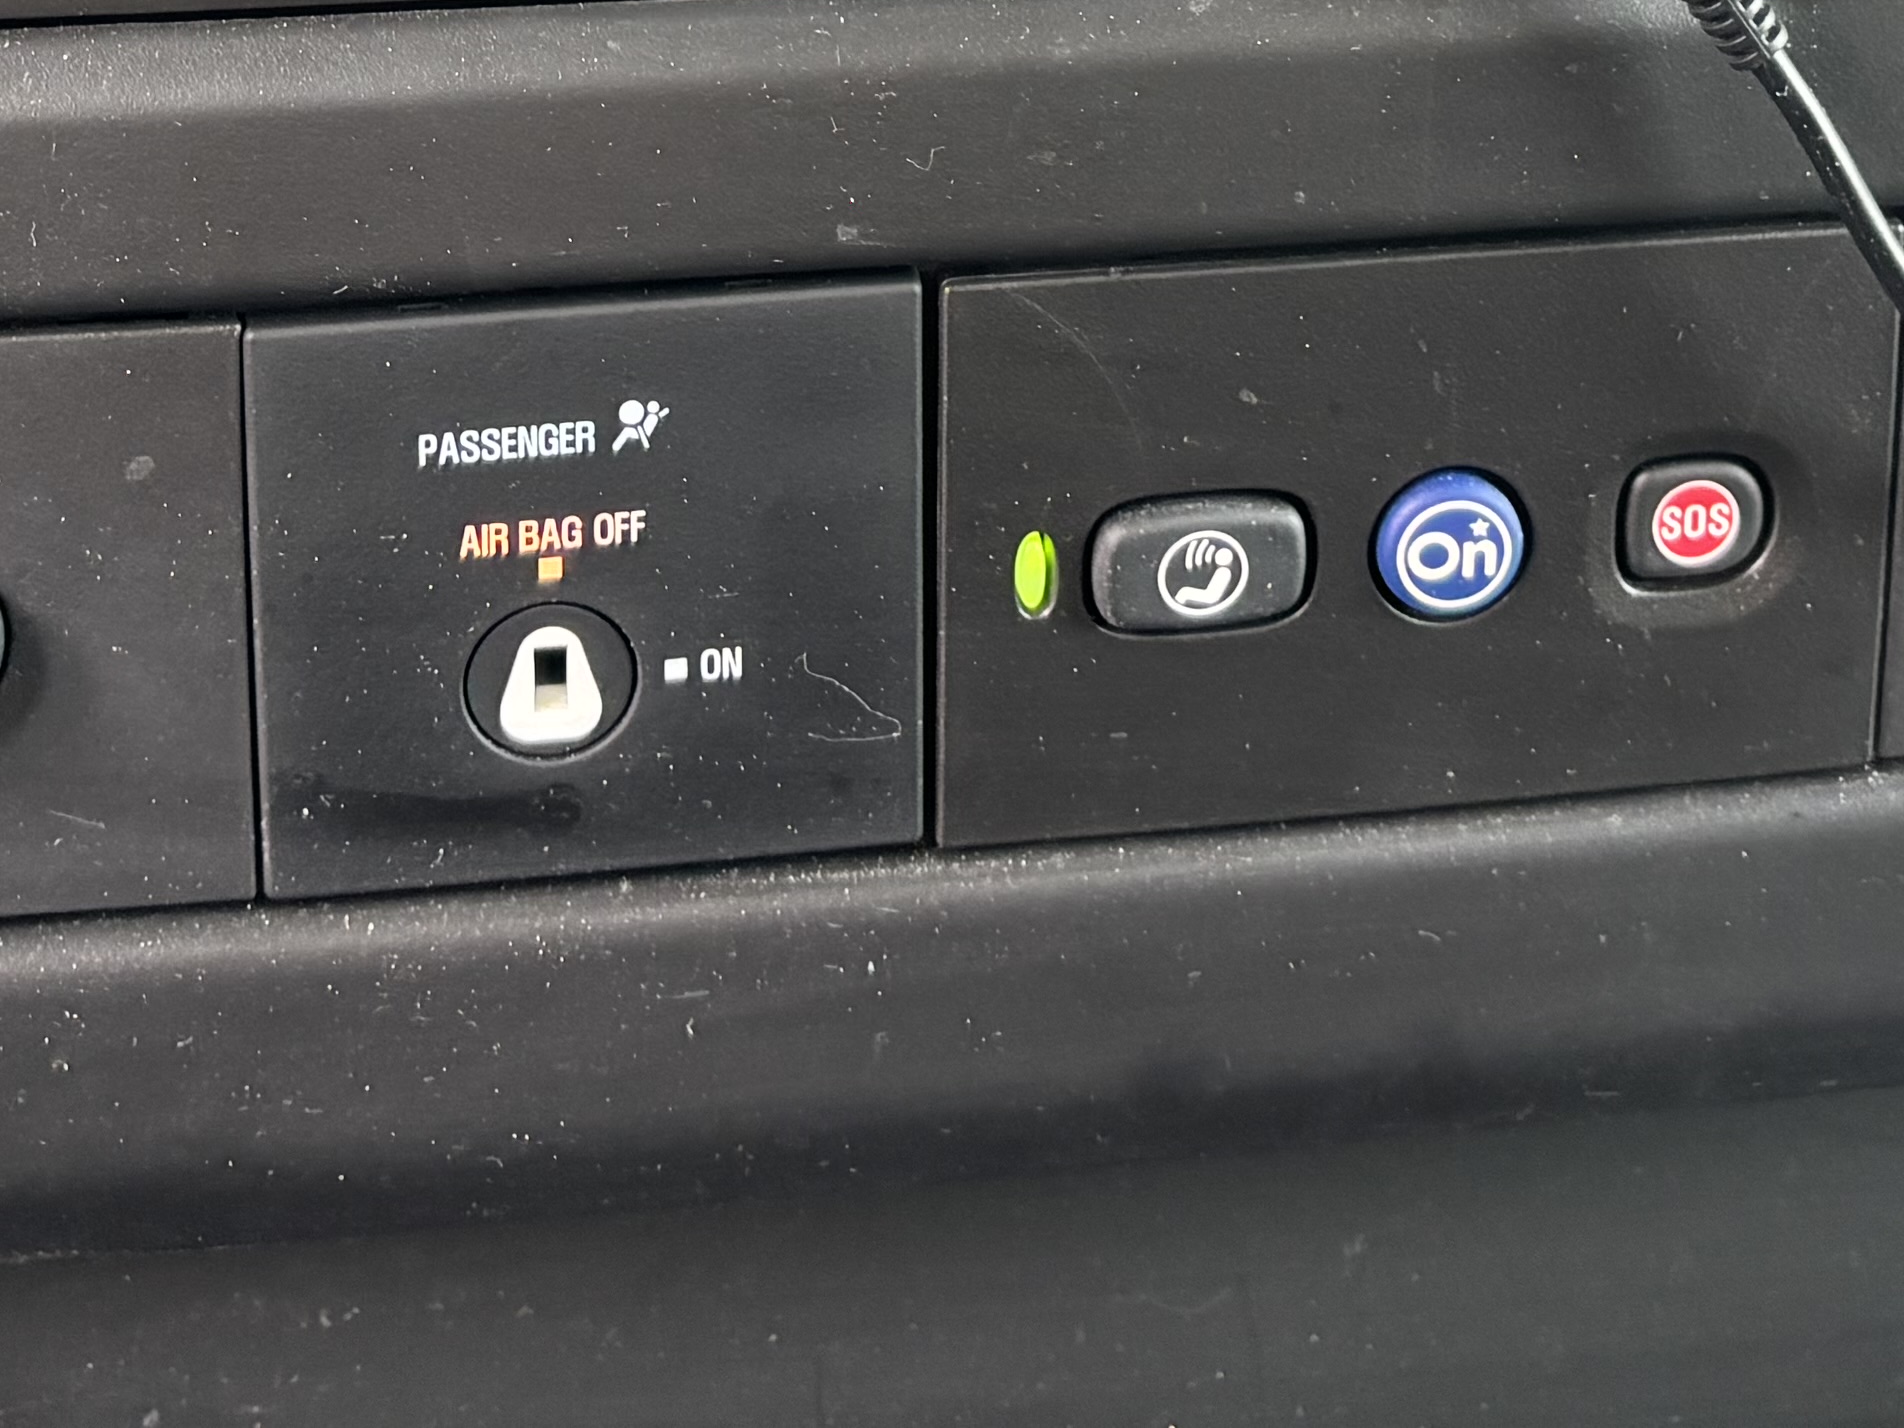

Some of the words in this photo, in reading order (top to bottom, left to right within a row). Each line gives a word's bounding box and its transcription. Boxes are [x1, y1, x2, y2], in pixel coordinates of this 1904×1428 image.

[417, 420, 596, 467] PASSENGER
[459, 522, 509, 560] AIR
[518, 515, 583, 553] BAG
[593, 509, 646, 545] OFF
[1661, 502, 1731, 541] SOS
[1407, 531, 1498, 581] On
[700, 646, 743, 680] ON
